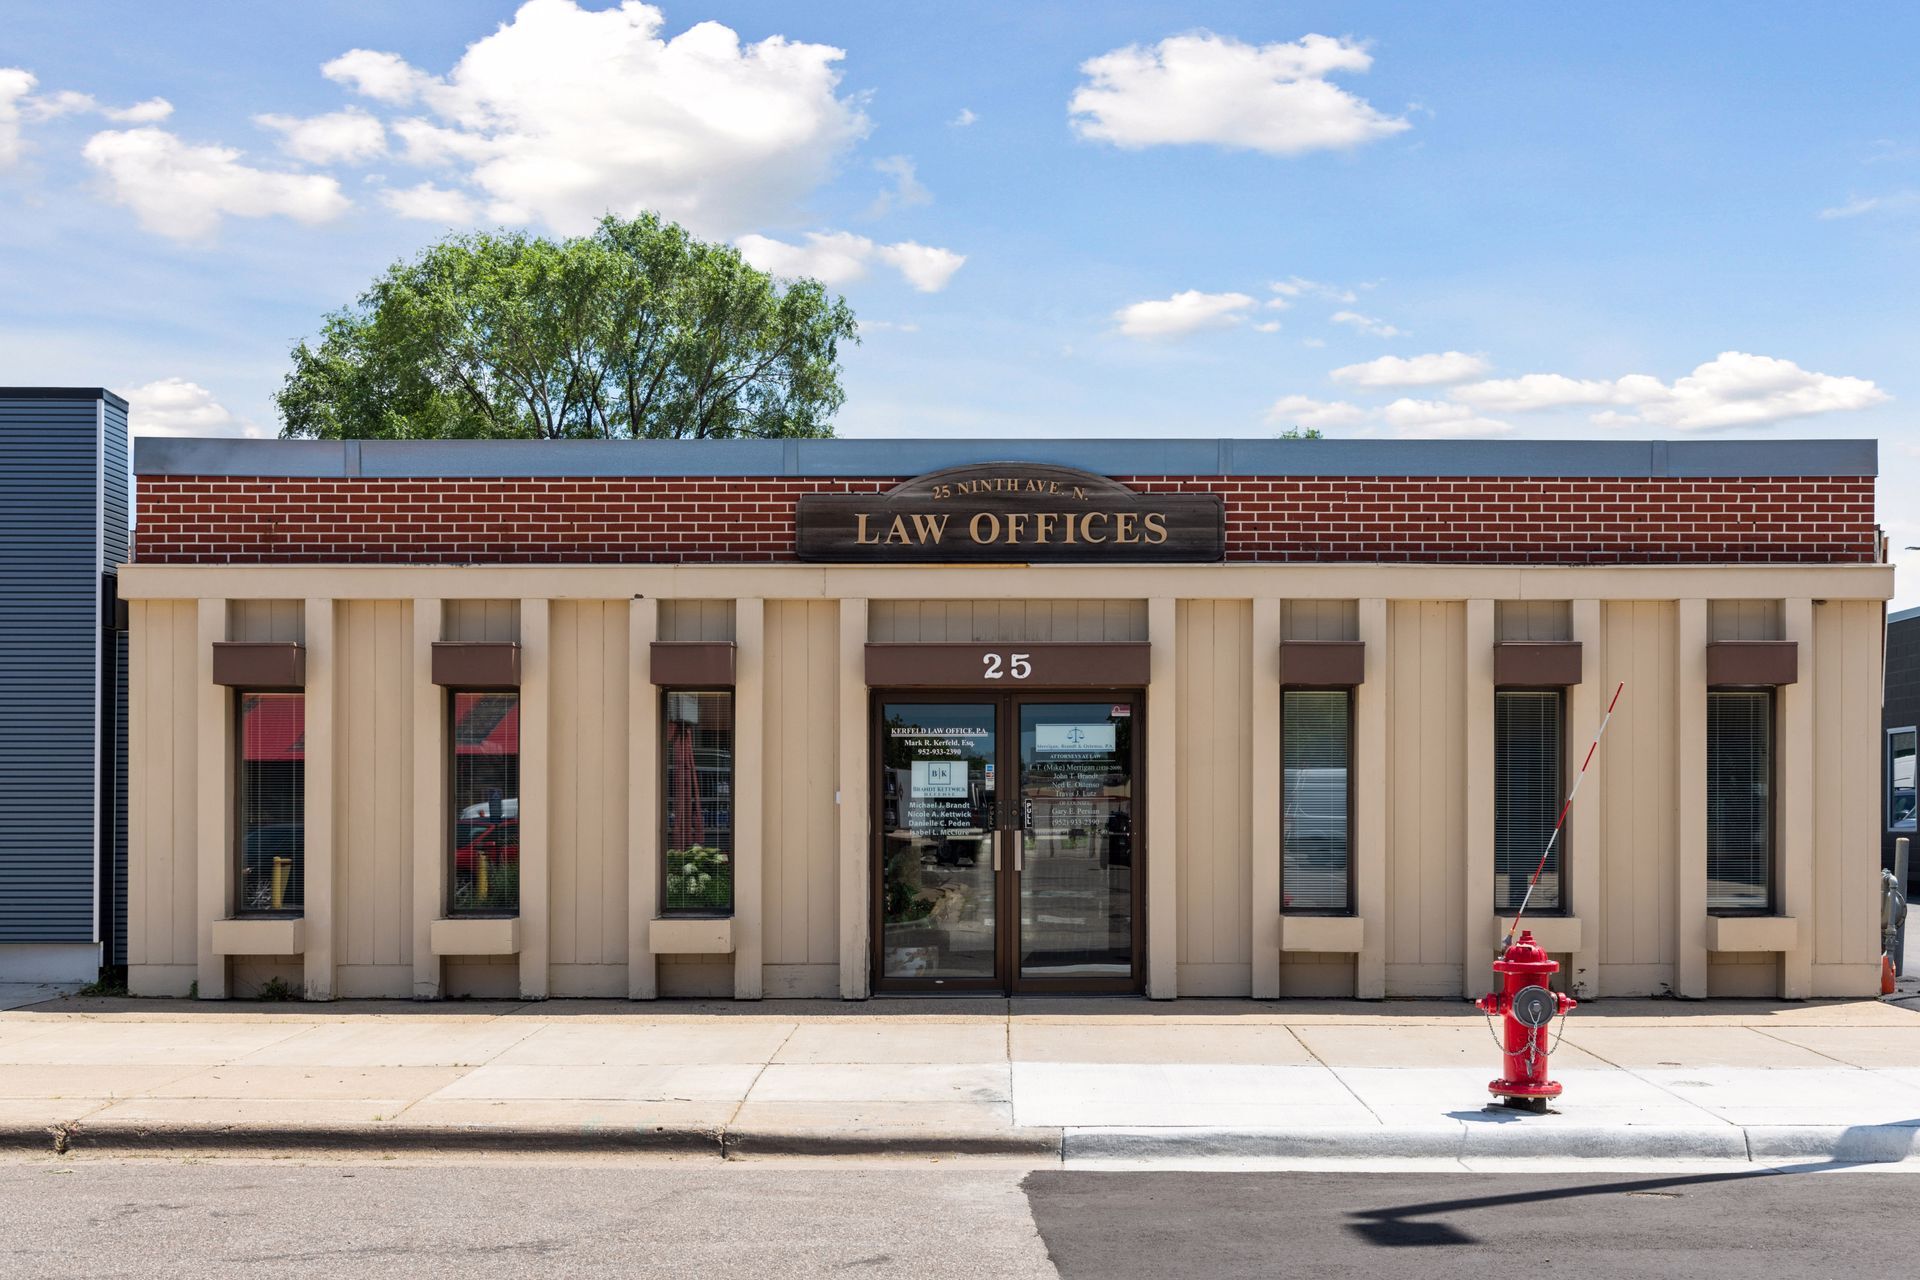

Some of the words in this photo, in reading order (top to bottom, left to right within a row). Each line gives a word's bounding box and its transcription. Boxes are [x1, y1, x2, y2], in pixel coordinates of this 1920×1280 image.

[933, 484, 951, 499] 25
[957, 478, 1019, 495] NINTH
[1025, 479, 1065, 495] AVE.
[1072, 486, 1089, 500] N.
[854, 513, 950, 545] LAW
[969, 512, 1169, 545] OFFICES
[983, 653, 1032, 679] 25
[1066, 764, 1095, 772] Merrigan
